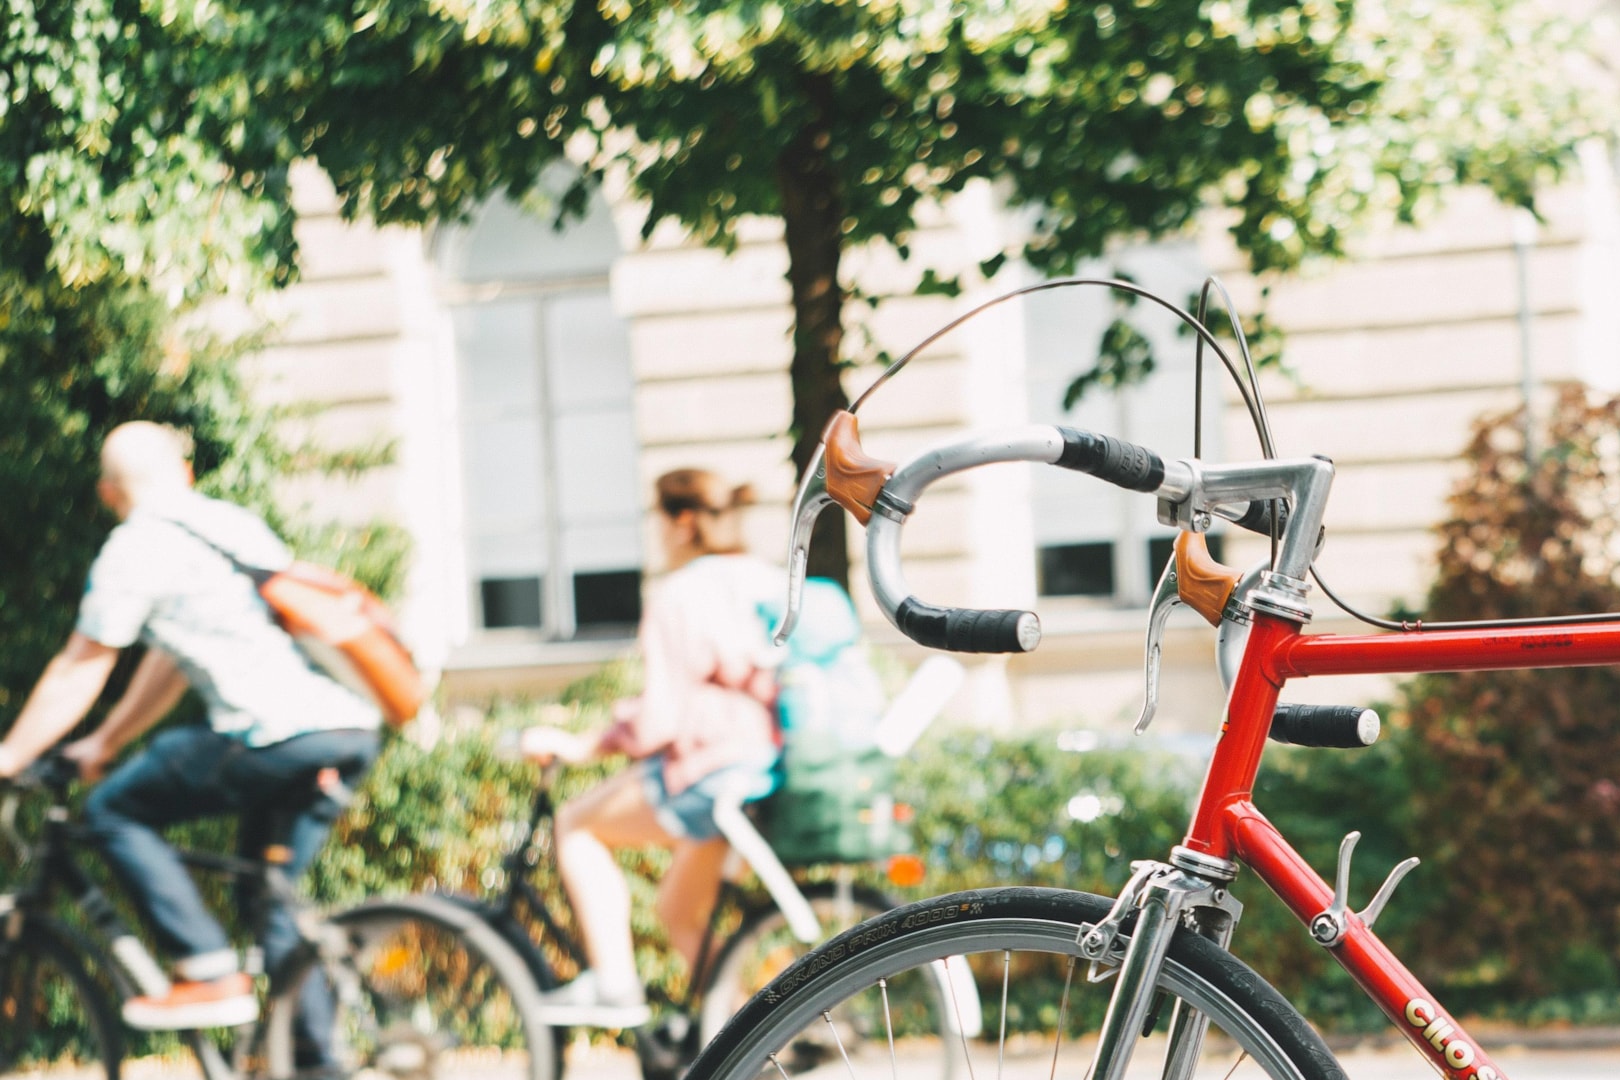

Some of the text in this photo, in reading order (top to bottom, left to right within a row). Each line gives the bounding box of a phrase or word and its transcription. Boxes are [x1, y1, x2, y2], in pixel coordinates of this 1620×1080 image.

[780, 941, 846, 993] GRAND
[848, 921, 898, 953] PRIX
[900, 904, 959, 930] 4000
[1404, 997, 1475, 1069] CILO
